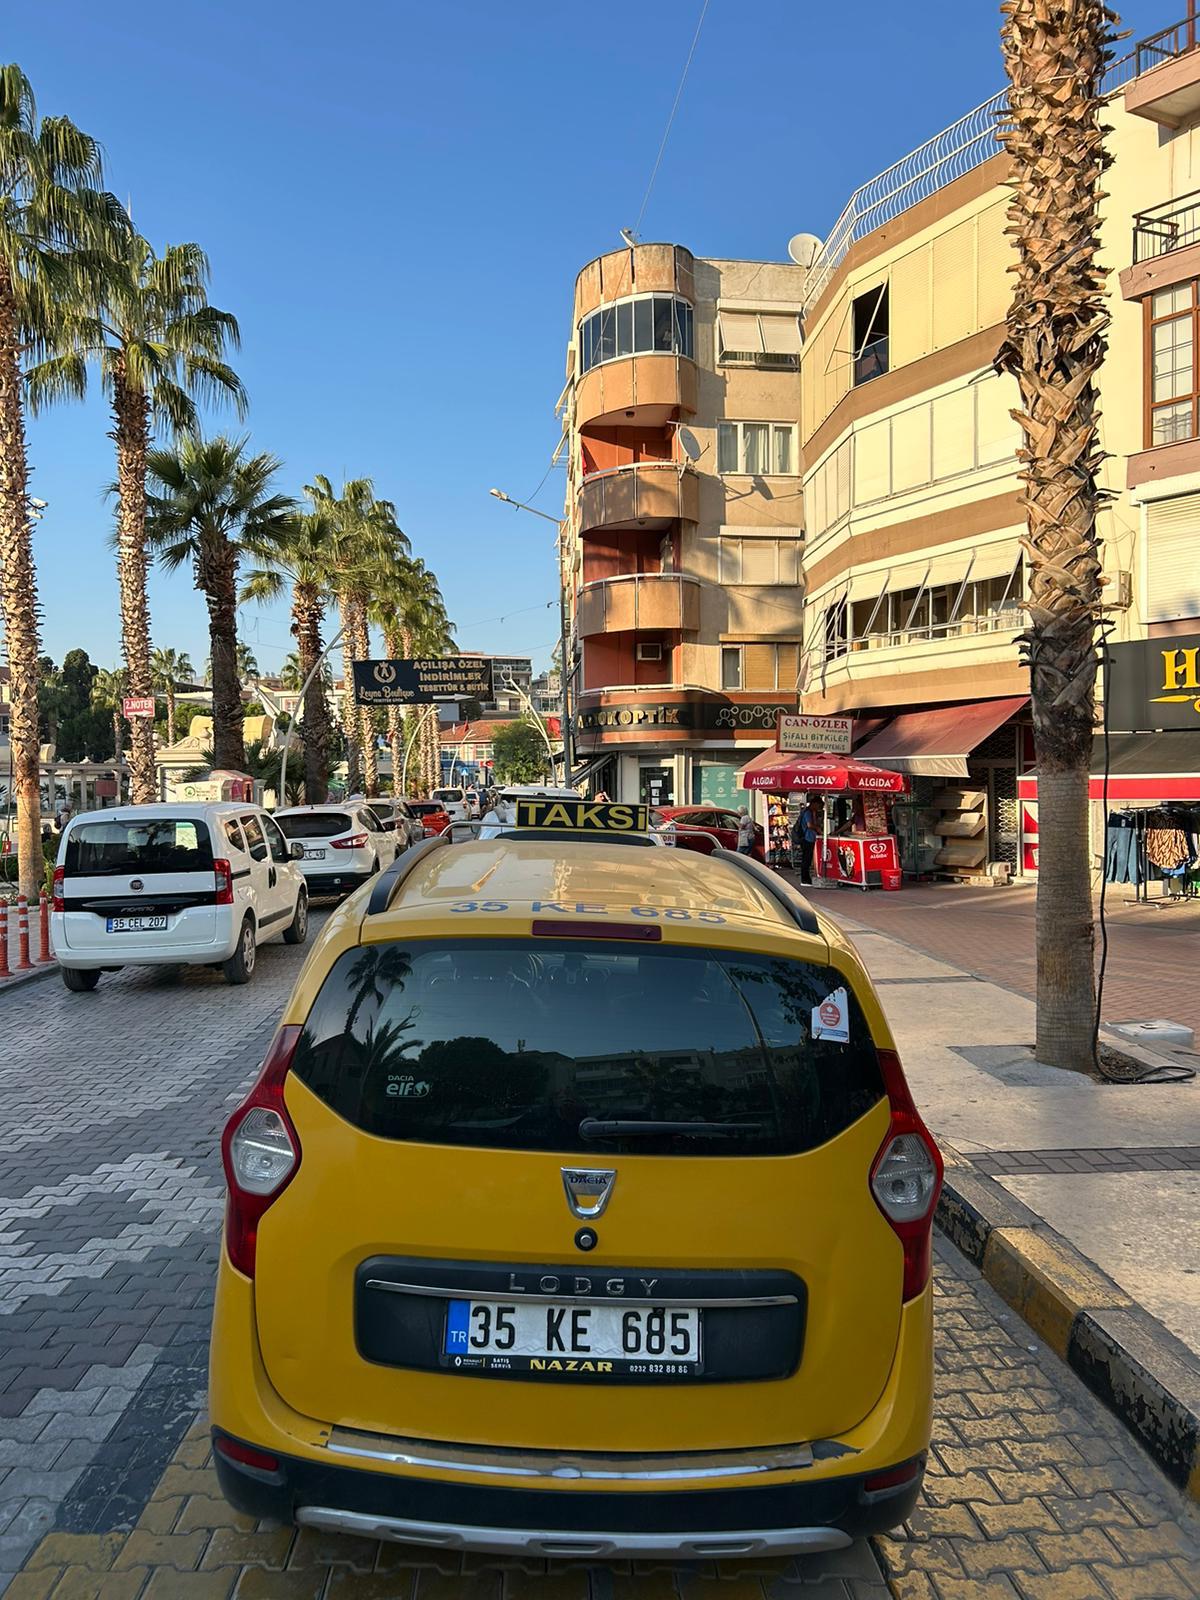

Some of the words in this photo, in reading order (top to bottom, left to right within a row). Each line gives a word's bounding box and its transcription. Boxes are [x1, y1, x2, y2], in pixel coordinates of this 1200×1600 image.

[413, 661, 456, 671] AÇILIŞA
[458, 659, 486, 669] ÖZEL
[419, 672, 482, 681] İNDİRİMLER
[450, 901, 509, 913] 35
[531, 901, 608, 915] KE
[631, 905, 727, 924] 685
[114, 919, 125, 928] 35
[128, 918, 144, 927] CEL
[149, 917, 165, 927] 207
[387, 1082, 414, 1095] elf
[570, 1176, 607, 1185] DACIA
[510, 1273, 658, 1295] LODGY
[451, 1330, 467, 1343] TR
[470, 1306, 516, 1349] 35
[547, 1308, 591, 1352] KE
[622, 1308, 690, 1355] 685
[530, 1359, 613, 1373] NAZAR
[649, 1364, 664, 1373] 832
[666, 1365, 676, 1374] 88
